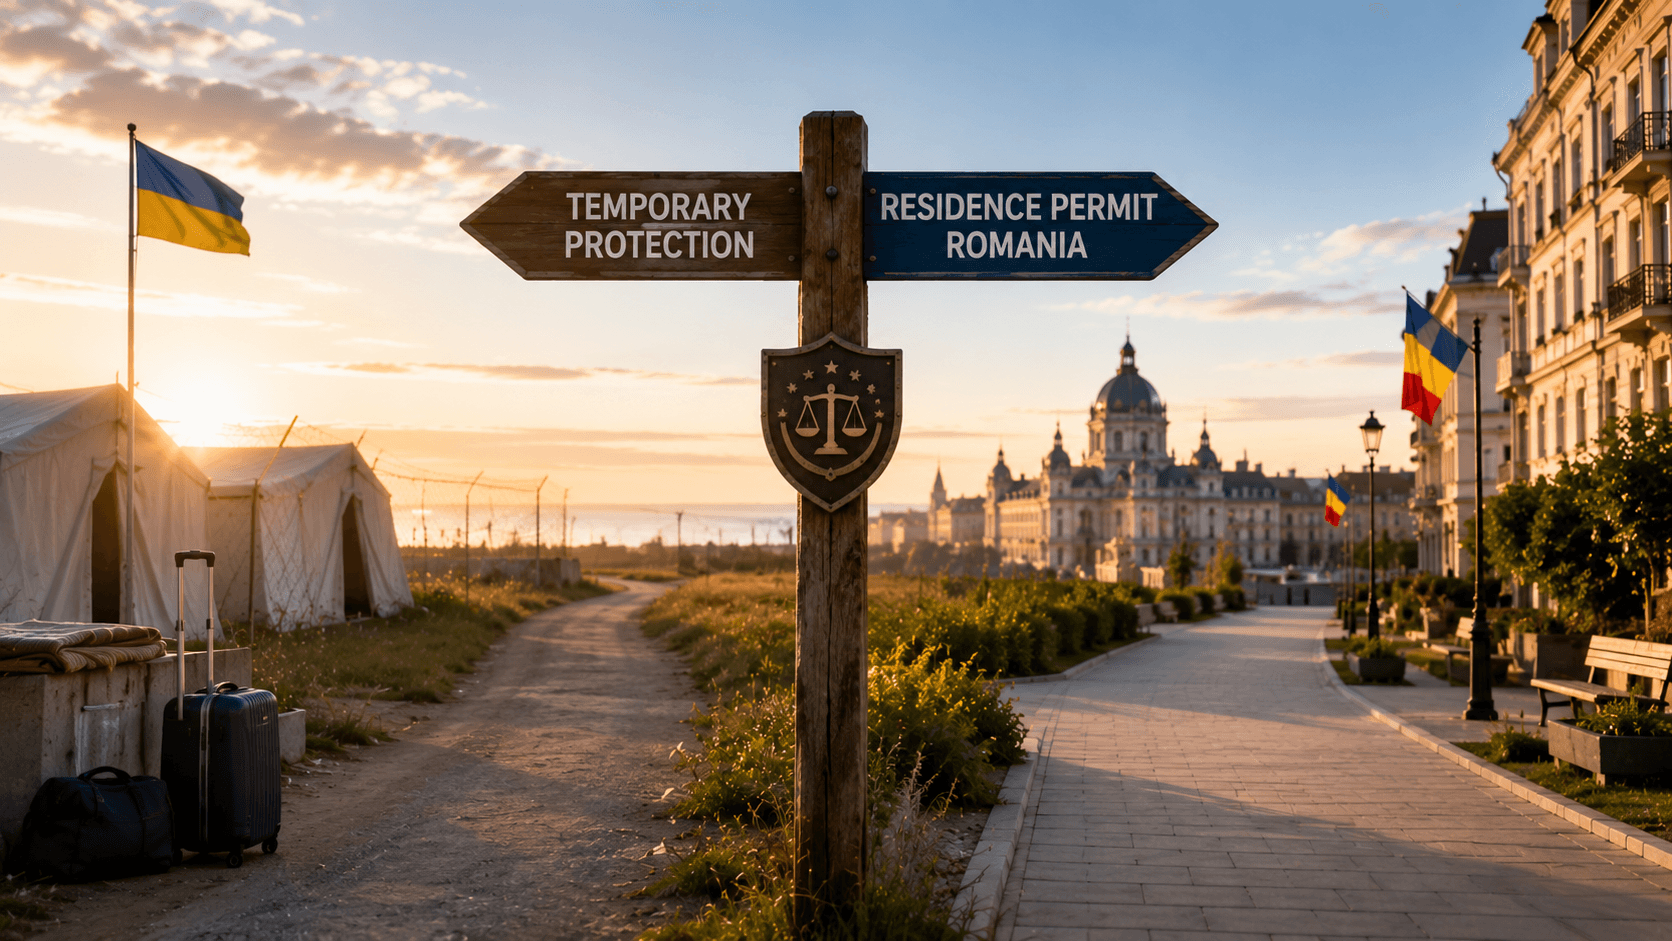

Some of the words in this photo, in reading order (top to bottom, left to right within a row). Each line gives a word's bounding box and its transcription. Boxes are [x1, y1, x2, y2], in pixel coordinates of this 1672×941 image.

[566, 192, 752, 221] TEMPORARY
[880, 192, 1041, 221] RESIDENCE
[1051, 193, 1158, 221] PERMIT
[565, 230, 754, 259] PROTECTION
[947, 231, 1088, 259] ROMANIA
